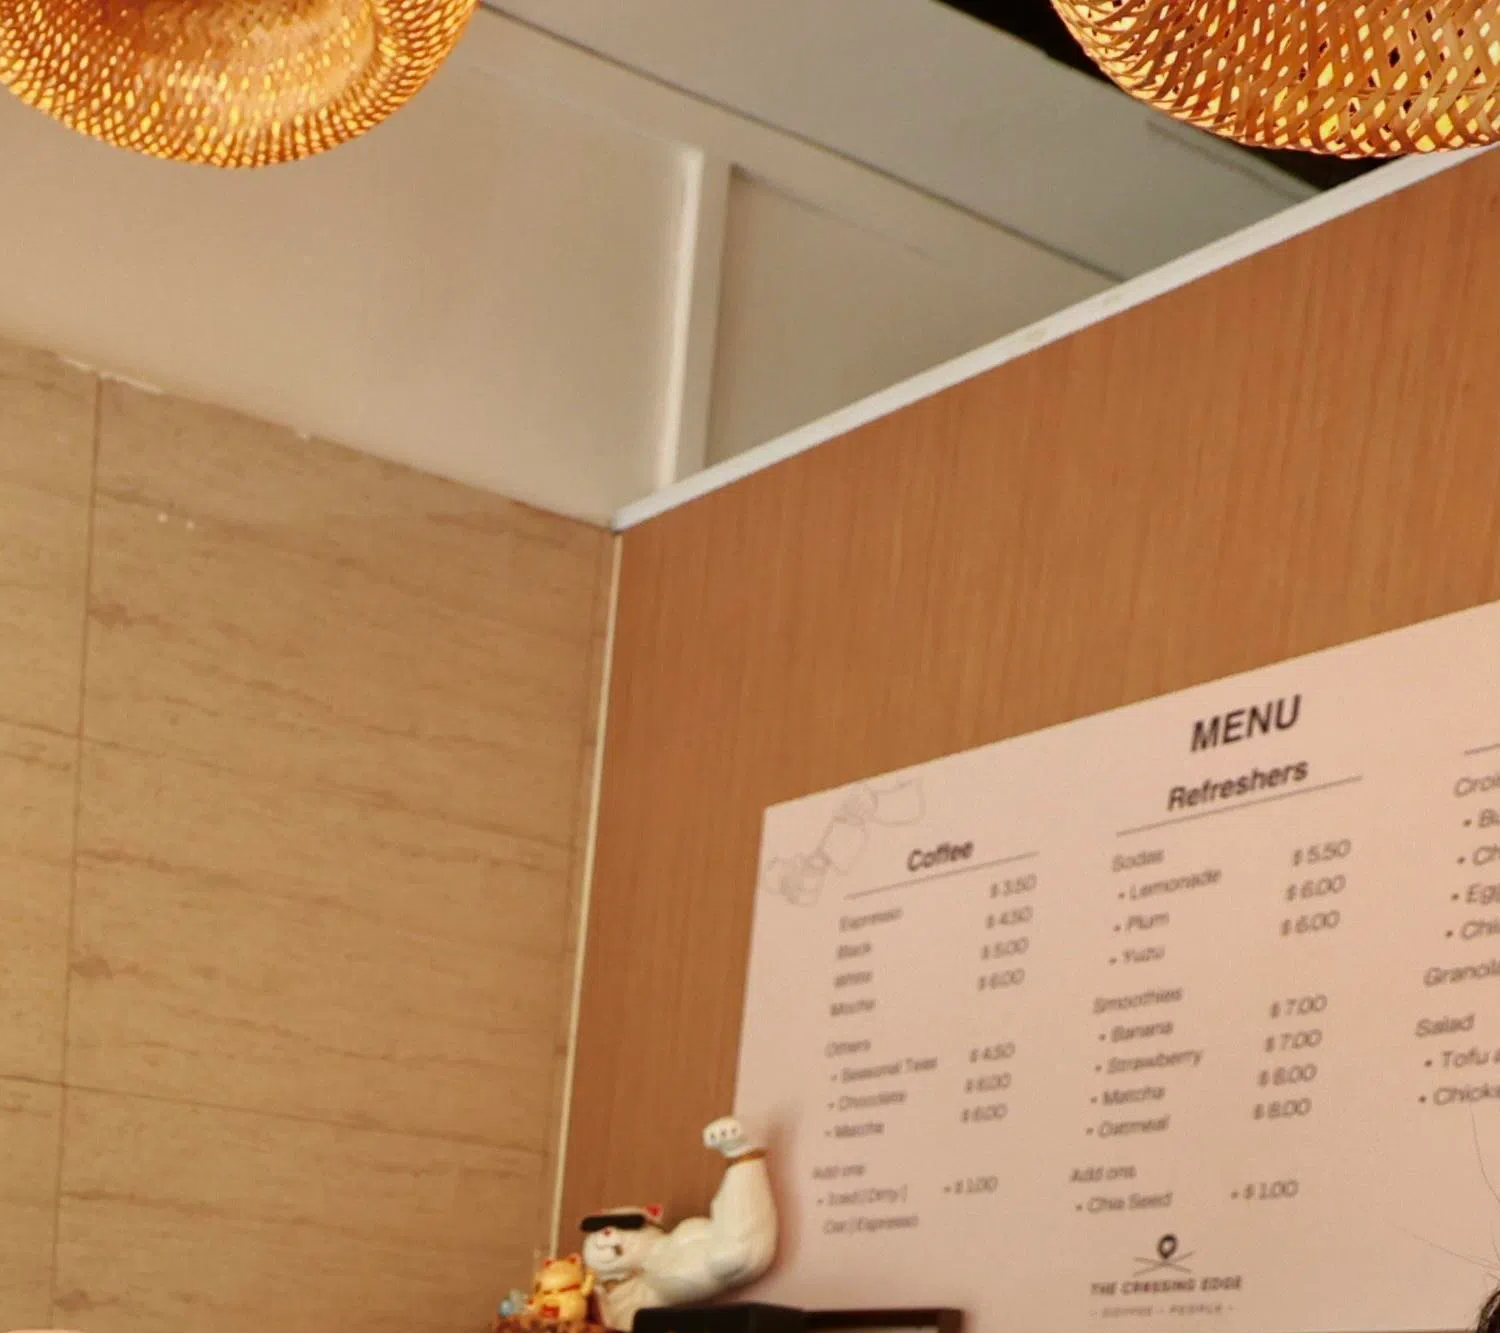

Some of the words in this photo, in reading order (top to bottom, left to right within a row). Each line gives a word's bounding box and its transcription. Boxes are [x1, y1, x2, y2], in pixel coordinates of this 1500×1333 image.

[1191, 695, 1301, 752] MENU
[1167, 761, 1308, 811] Refreshers
[907, 841, 974, 871] Coffee
[1415, 1013, 1476, 1038] Salad
[1440, 1045, 1489, 1069] Tofu
